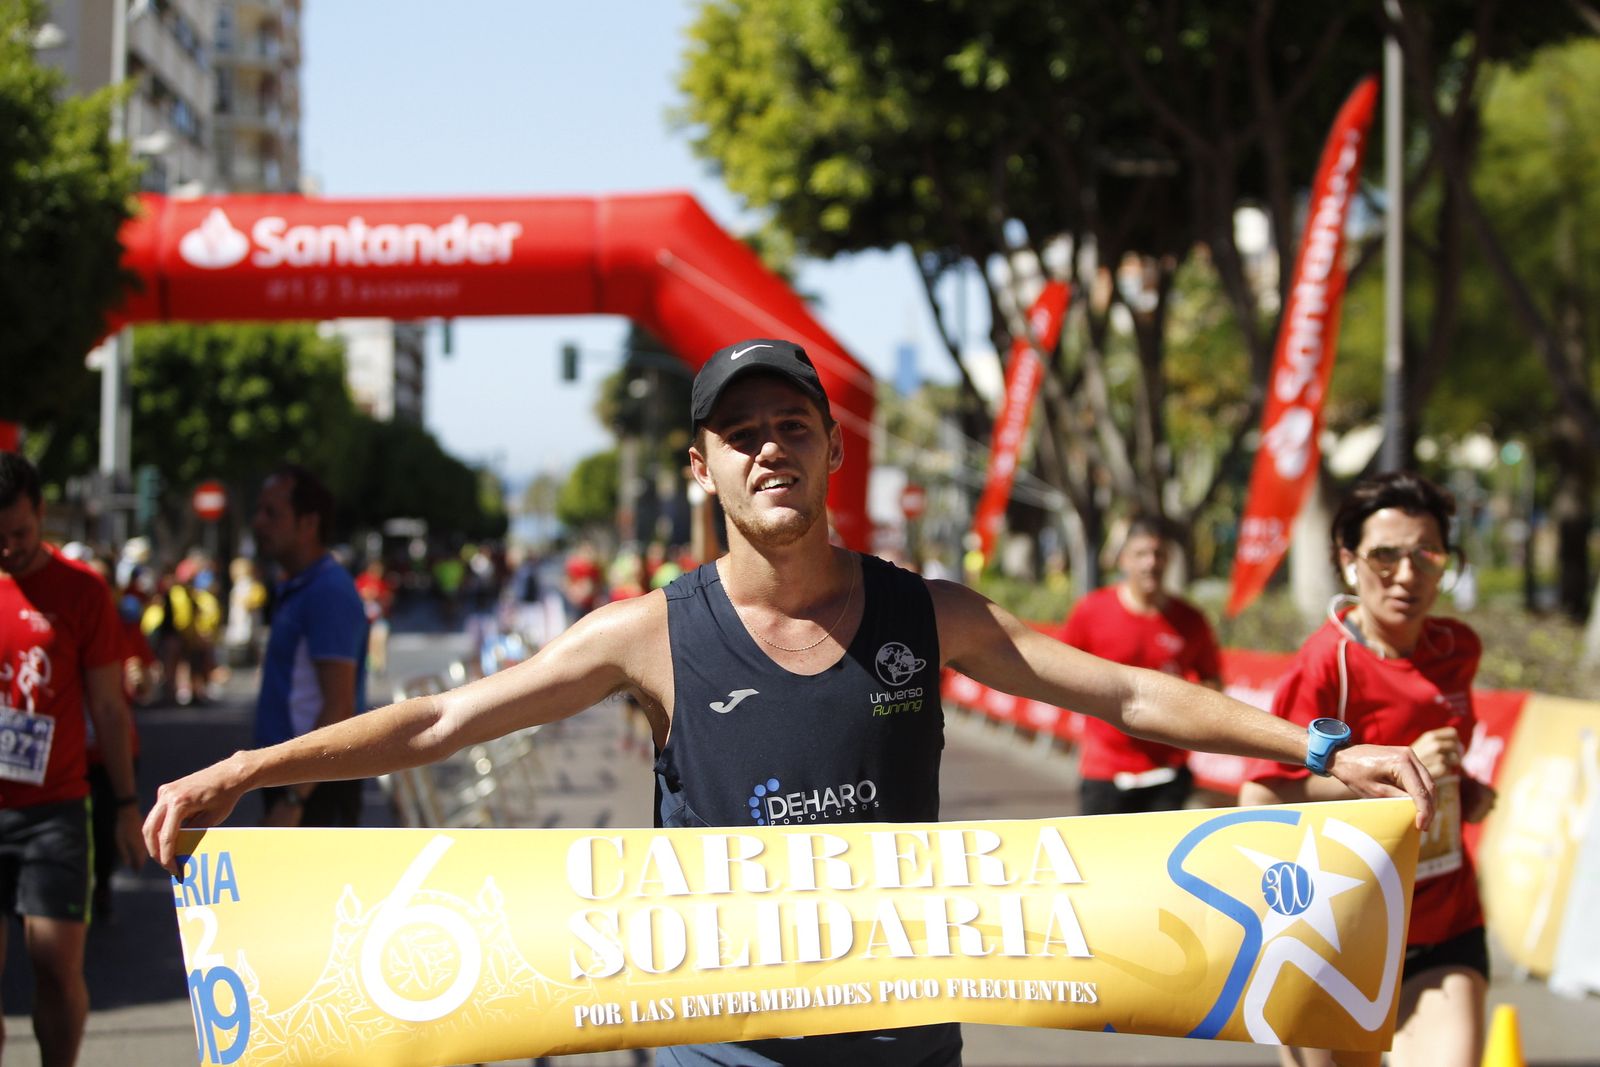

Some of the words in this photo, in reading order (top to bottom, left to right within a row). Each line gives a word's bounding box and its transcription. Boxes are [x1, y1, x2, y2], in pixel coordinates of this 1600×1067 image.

[251, 214, 522, 268] Santander
[870, 687, 923, 704] Universo
[873, 700, 922, 717] Running
[766, 780, 877, 820] DEHARO
[770, 801, 880, 826] PODOLOGOS
[566, 826, 1088, 900] CARRERA
[177, 905, 225, 970] 2
[361, 833, 482, 1023] 6
[569, 892, 1095, 980] SOLIDARIA
[573, 1003, 624, 1027] POR
[630, 997, 676, 1023] LAS
[681, 982, 872, 1018] ENFERMEDADES
[877, 978, 940, 1003] POCO
[946, 978, 1098, 1004] FRECUENTES
